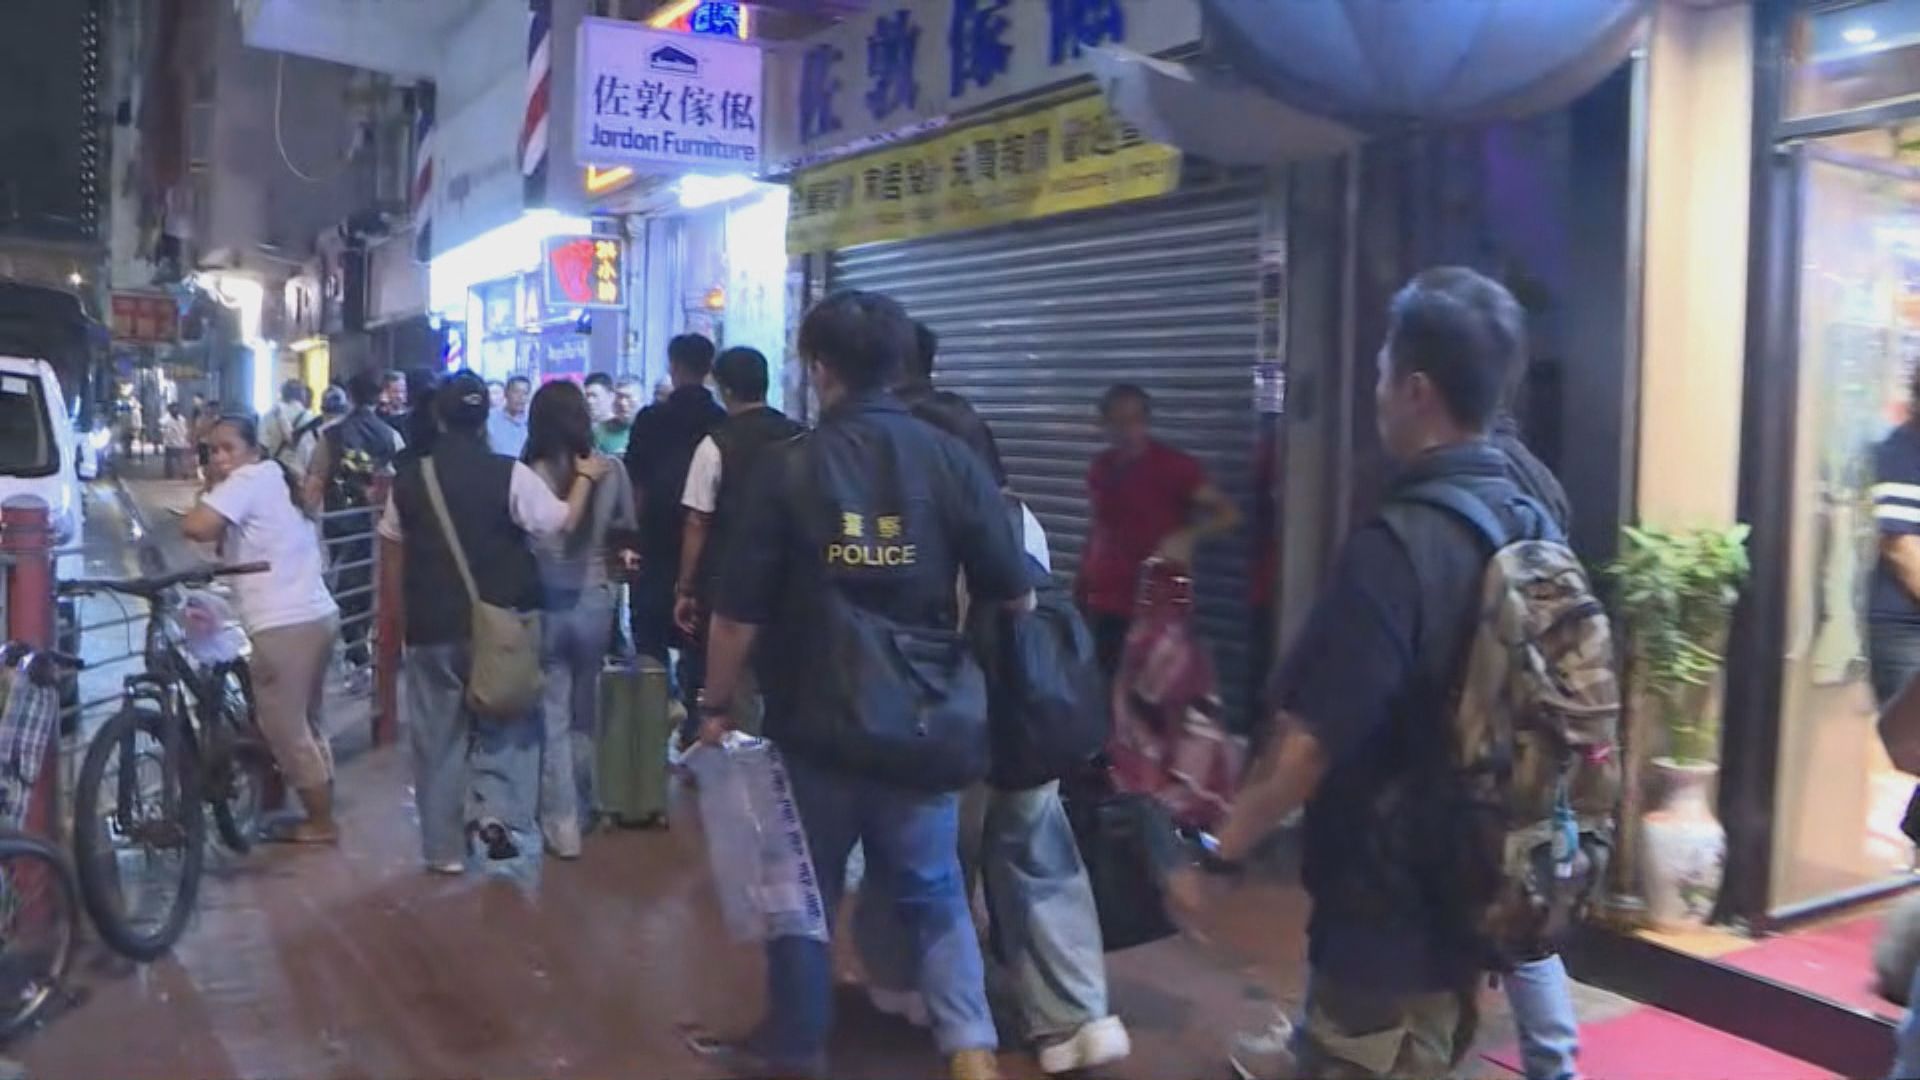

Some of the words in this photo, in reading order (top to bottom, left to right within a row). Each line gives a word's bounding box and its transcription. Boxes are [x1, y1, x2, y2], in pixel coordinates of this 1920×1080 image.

[594, 73, 755, 132] 佐敦傢俬
[663, 131, 755, 162] Furniture
[842, 511, 901, 538] 警察
[827, 543, 917, 566] POLICE
